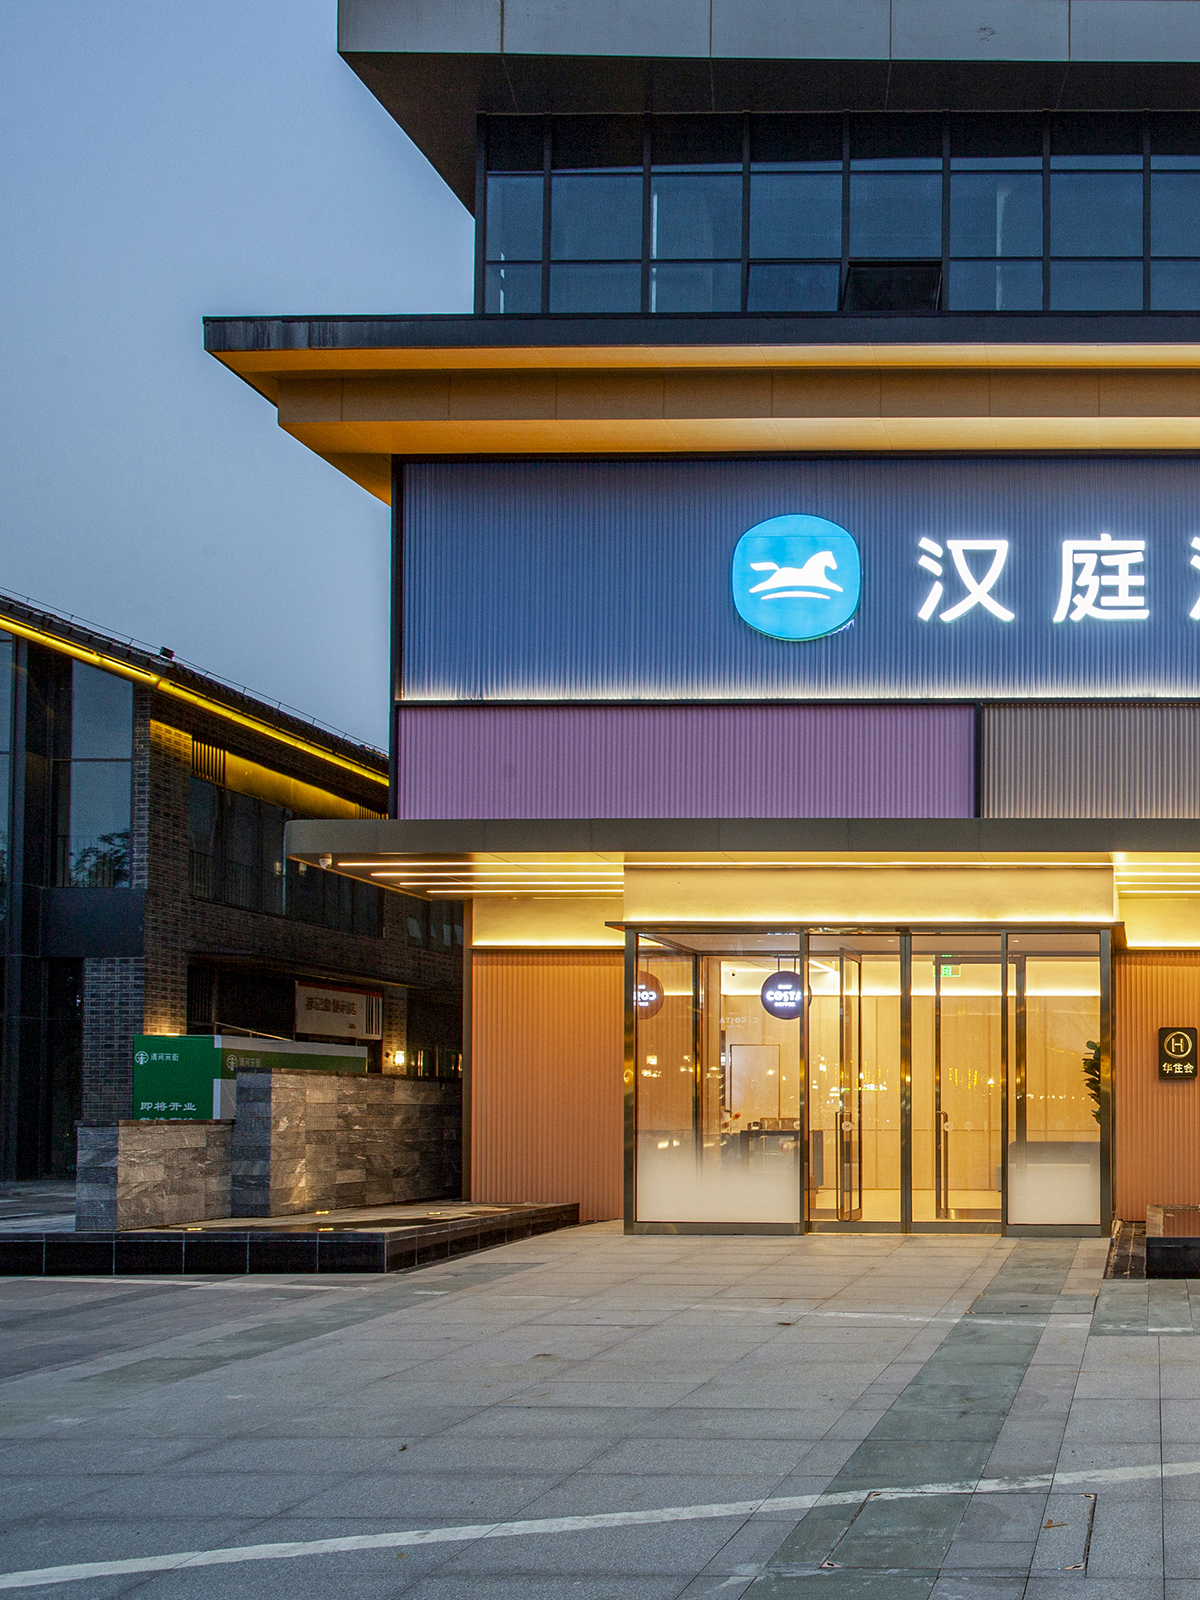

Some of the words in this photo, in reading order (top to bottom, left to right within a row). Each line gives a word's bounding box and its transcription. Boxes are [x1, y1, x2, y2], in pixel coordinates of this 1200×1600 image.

[1162, 1062, 1194, 1074] 华住会
[140, 1102, 197, 1111] 即将开业
